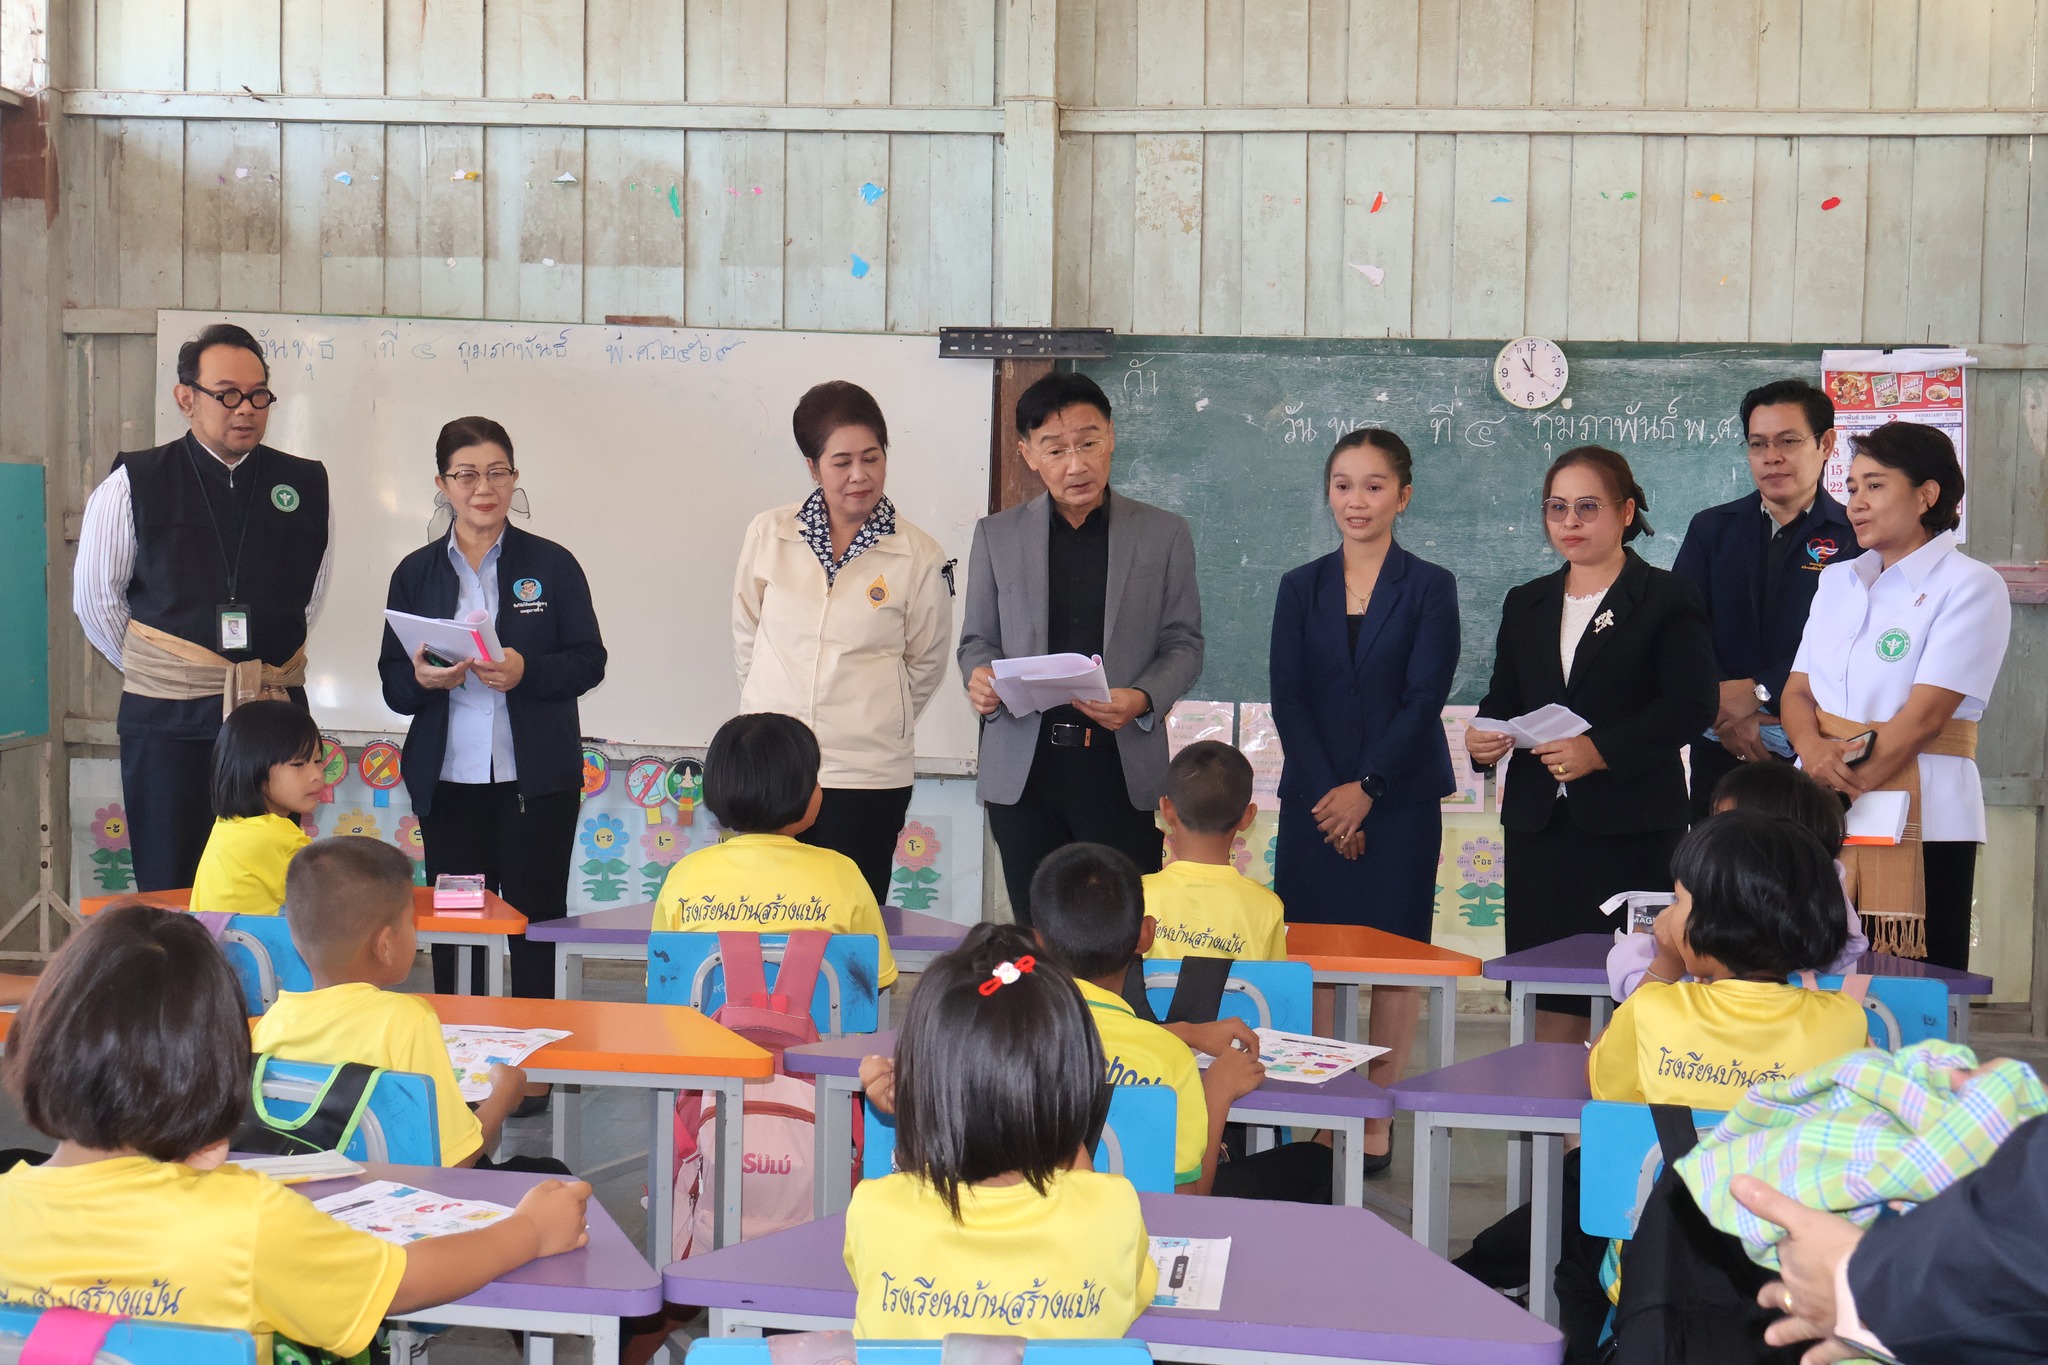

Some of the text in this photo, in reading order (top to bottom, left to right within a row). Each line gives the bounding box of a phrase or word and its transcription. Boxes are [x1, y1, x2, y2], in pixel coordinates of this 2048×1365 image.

[457, 328, 572, 373] กุมภาพันธ์
[1527, 343, 1537, 351] 12
[1501, 367, 1509, 378] 9
[1554, 367, 1561, 378] 3
[1526, 391, 1535, 402] 6
[1429, 401, 1455, 444] ที่
[1533, 396, 1683, 460] กุมภาพันธ์
[1832, 448, 1840, 459] 8
[1830, 465, 1843, 476] 15
[1829, 481, 1843, 493] 22
[677, 893, 831, 924] โรงเรียนบ้านสร้างแป้น
[881, 1271, 1107, 1325] โรงเรียนบ้านสร้างแป้น
